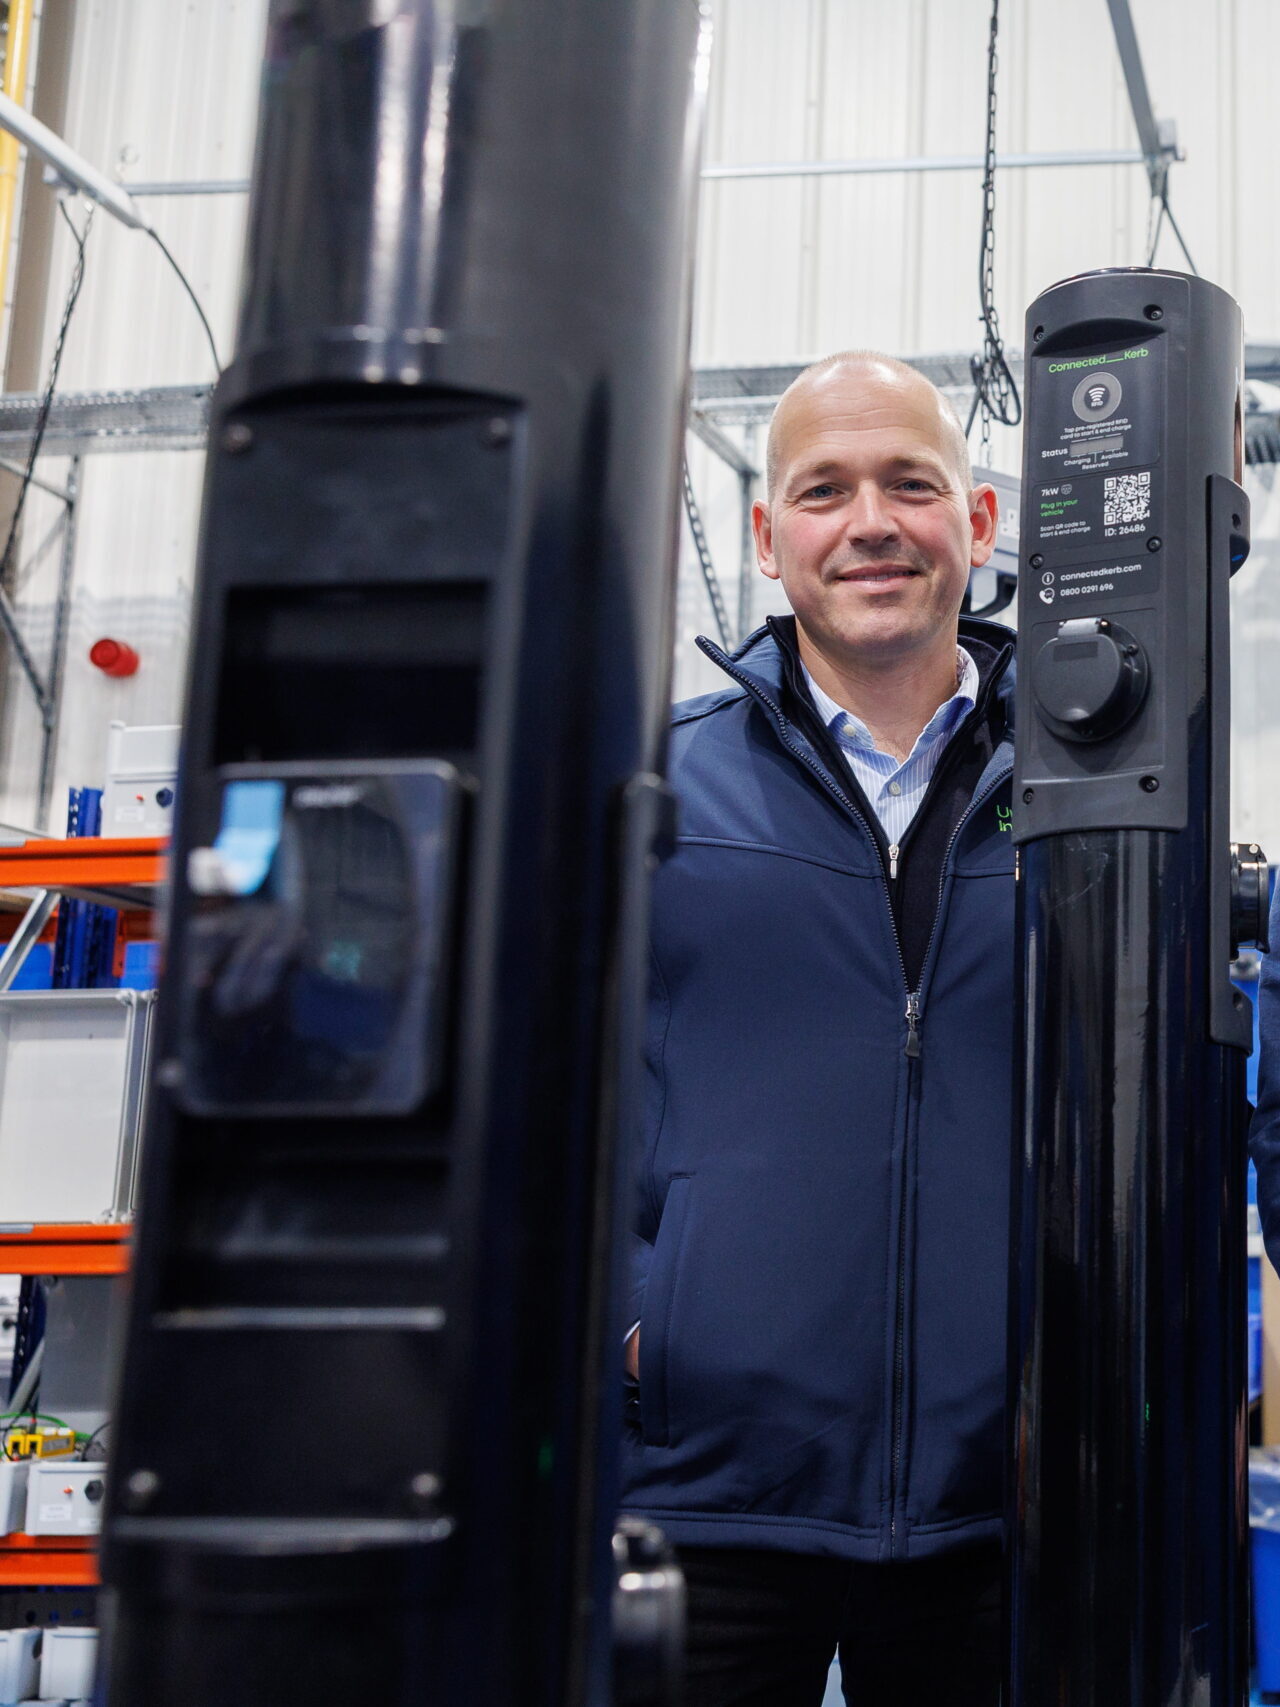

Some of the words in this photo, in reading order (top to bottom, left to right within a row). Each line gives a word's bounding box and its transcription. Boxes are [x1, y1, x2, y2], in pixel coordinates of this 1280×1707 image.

[1048, 354, 1106, 374] Connected
[1124, 347, 1149, 360] Kerb
[1041, 448, 1068, 458] Status
[1063, 457, 1092, 466] Charging
[1101, 451, 1129, 460] Available
[1082, 461, 1109, 470] Reserved
[1041, 487, 1059, 497] 7kW
[1040, 502, 1055, 510] Plug
[1040, 509, 1064, 517] vehicle
[1104, 528, 1117, 537] ID:
[1118, 524, 1146, 535] 26486
[1060, 563, 1142, 581] connectedkerb.com
[1060, 587, 1080, 597] 0800
[1081, 585, 1098, 594] 0291
[1099, 583, 1114, 592] 696
